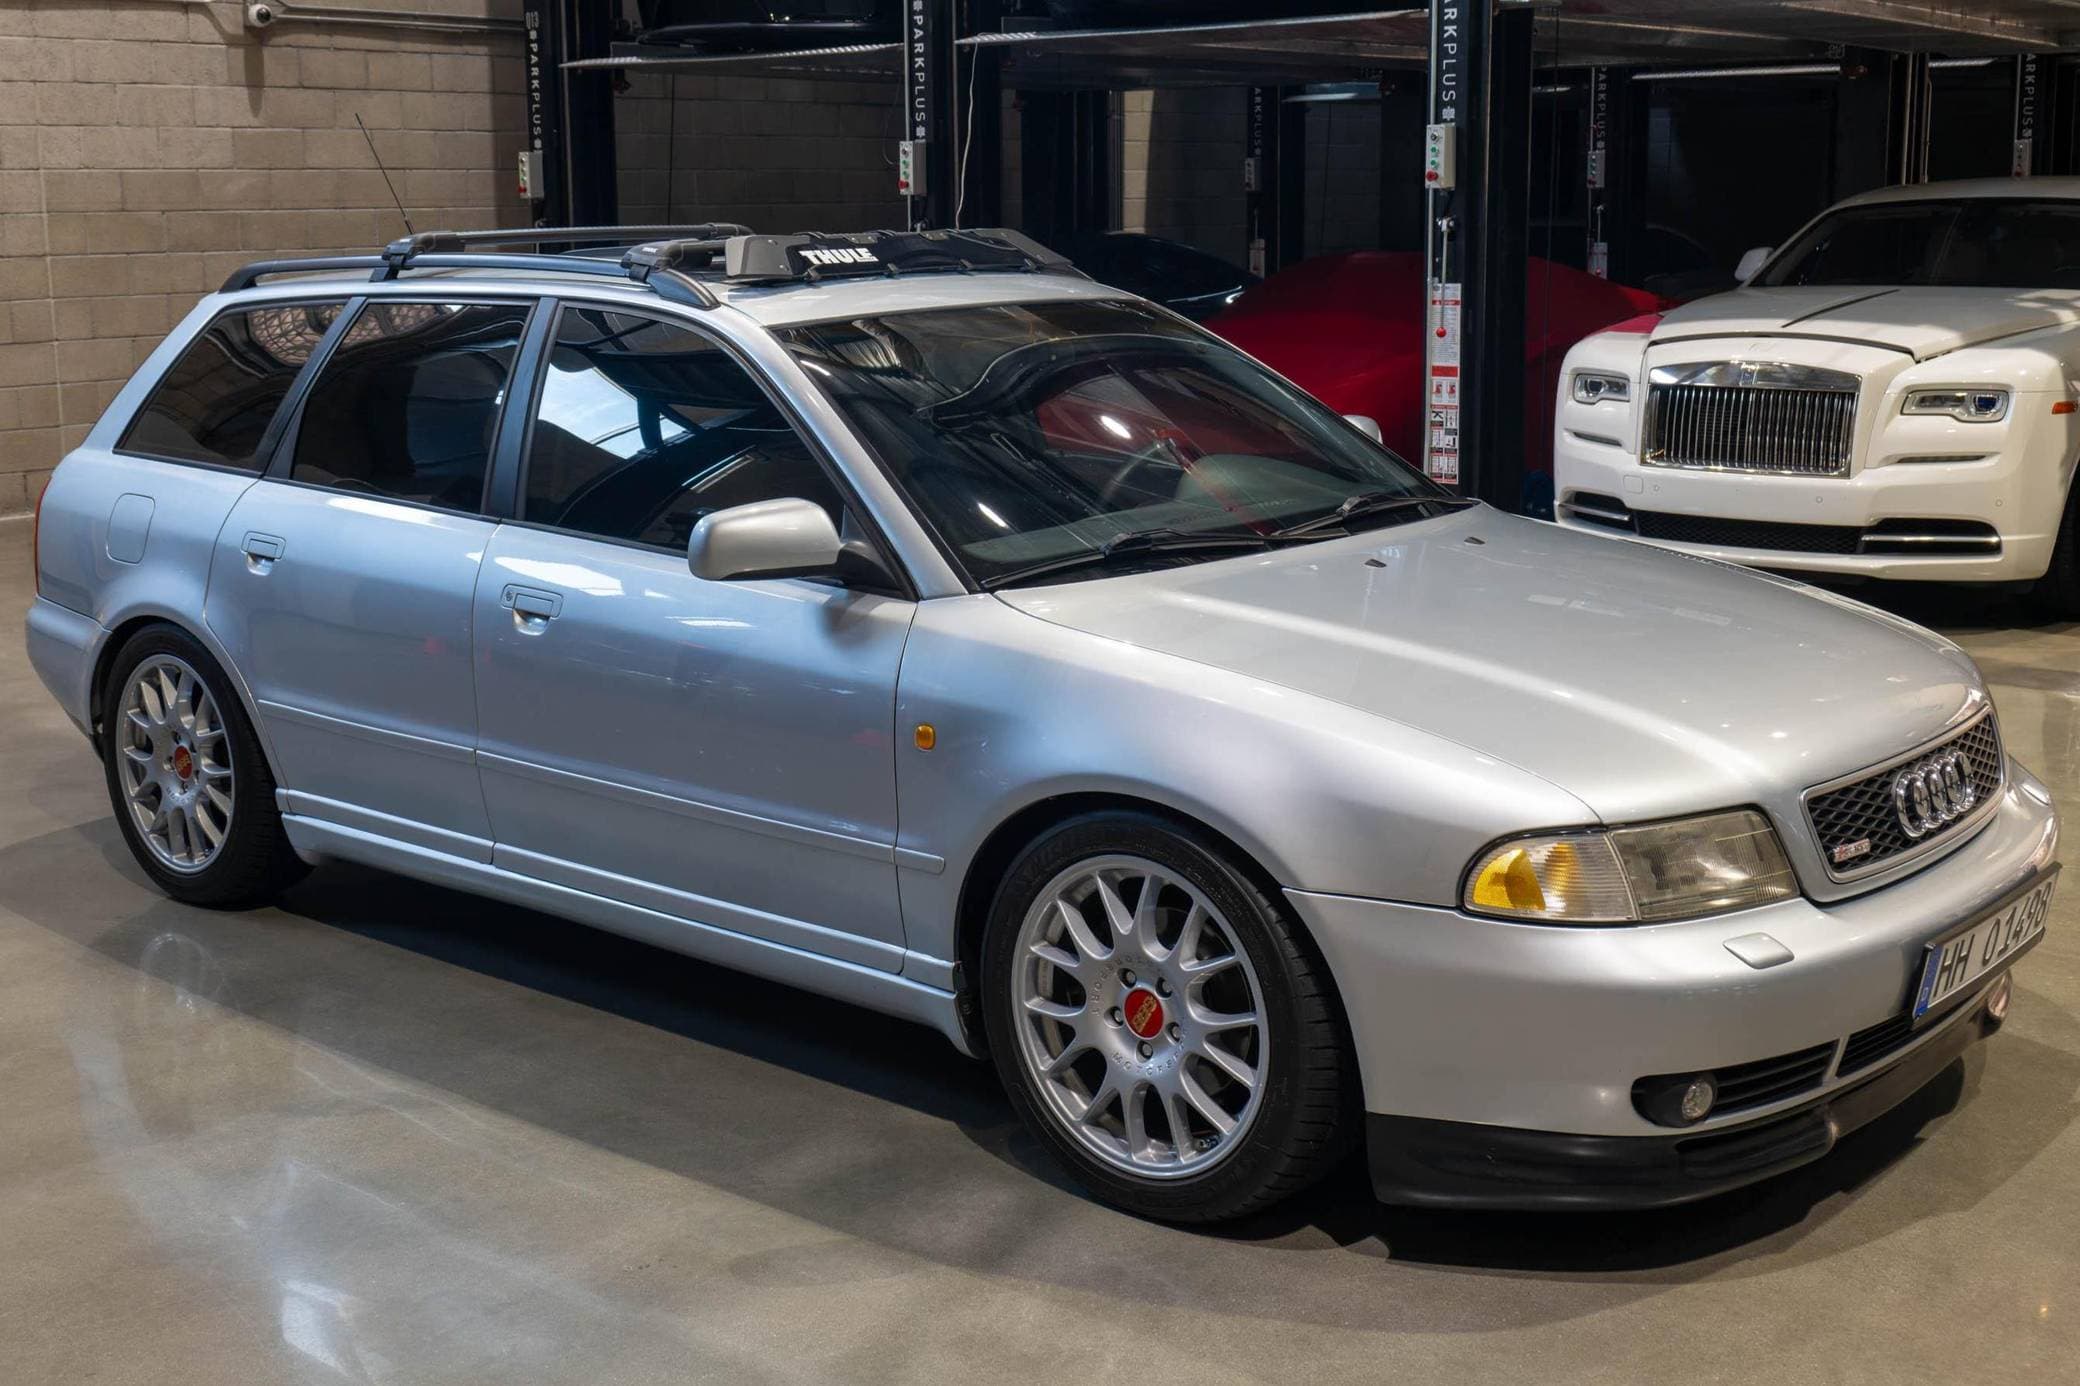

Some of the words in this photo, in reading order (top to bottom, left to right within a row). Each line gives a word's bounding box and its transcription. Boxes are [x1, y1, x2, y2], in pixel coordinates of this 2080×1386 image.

[530, 43, 542, 135] PARKPLUS
[913, 15, 926, 122] PARKPLUS
[1442, 0, 1457, 101] RKPLUS
[798, 248, 879, 264] THULE
[1933, 934, 1975, 997] HH
